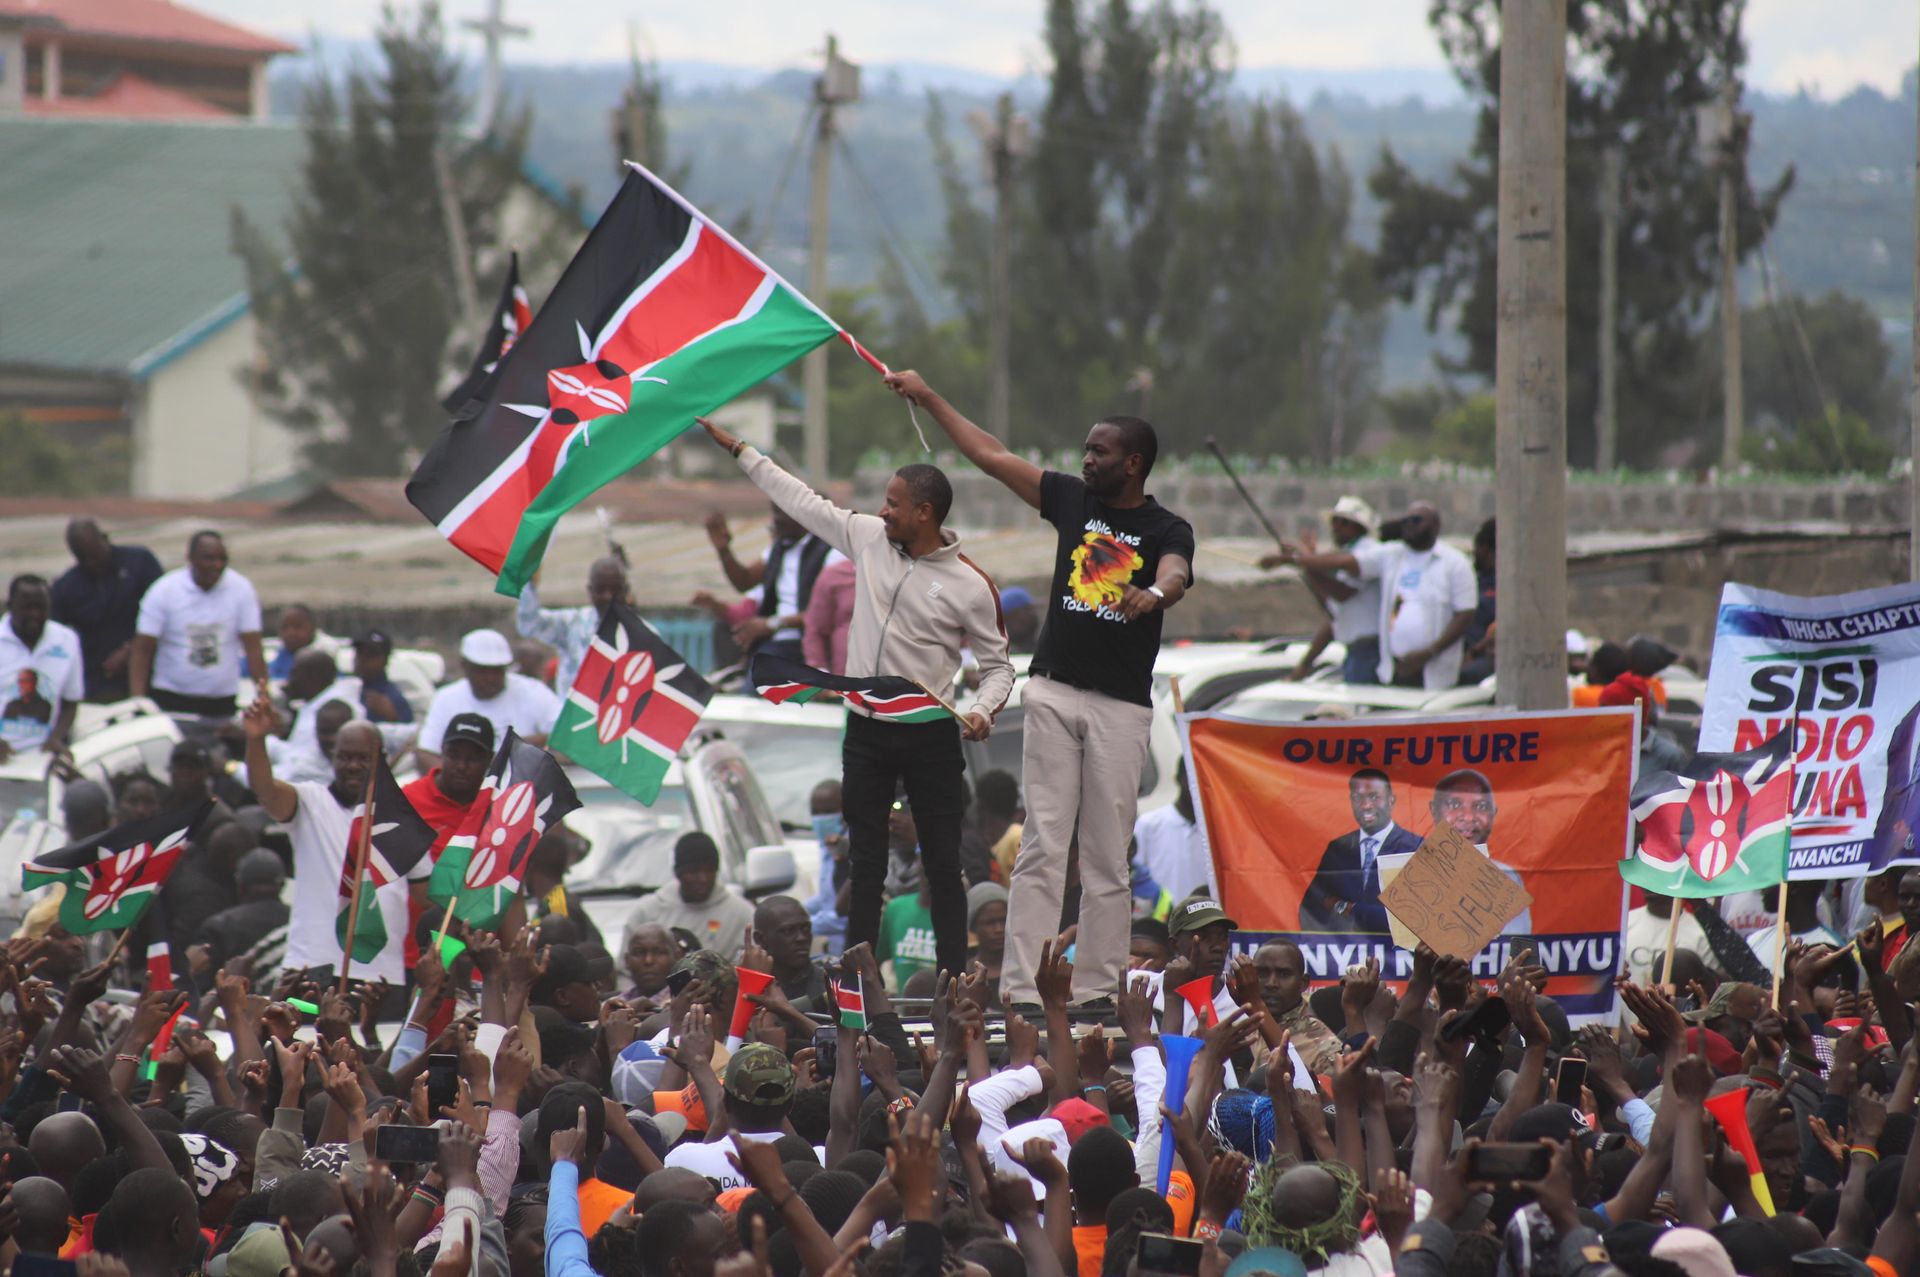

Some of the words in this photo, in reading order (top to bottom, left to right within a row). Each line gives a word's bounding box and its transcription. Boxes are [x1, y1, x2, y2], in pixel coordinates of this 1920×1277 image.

[1748, 659, 1878, 713] SISI
[1283, 738, 1371, 766] OUR
[1383, 731, 1540, 766] FUTURE
[1733, 714, 1875, 764] NDIO
[1788, 842, 1864, 868] NANCHI
